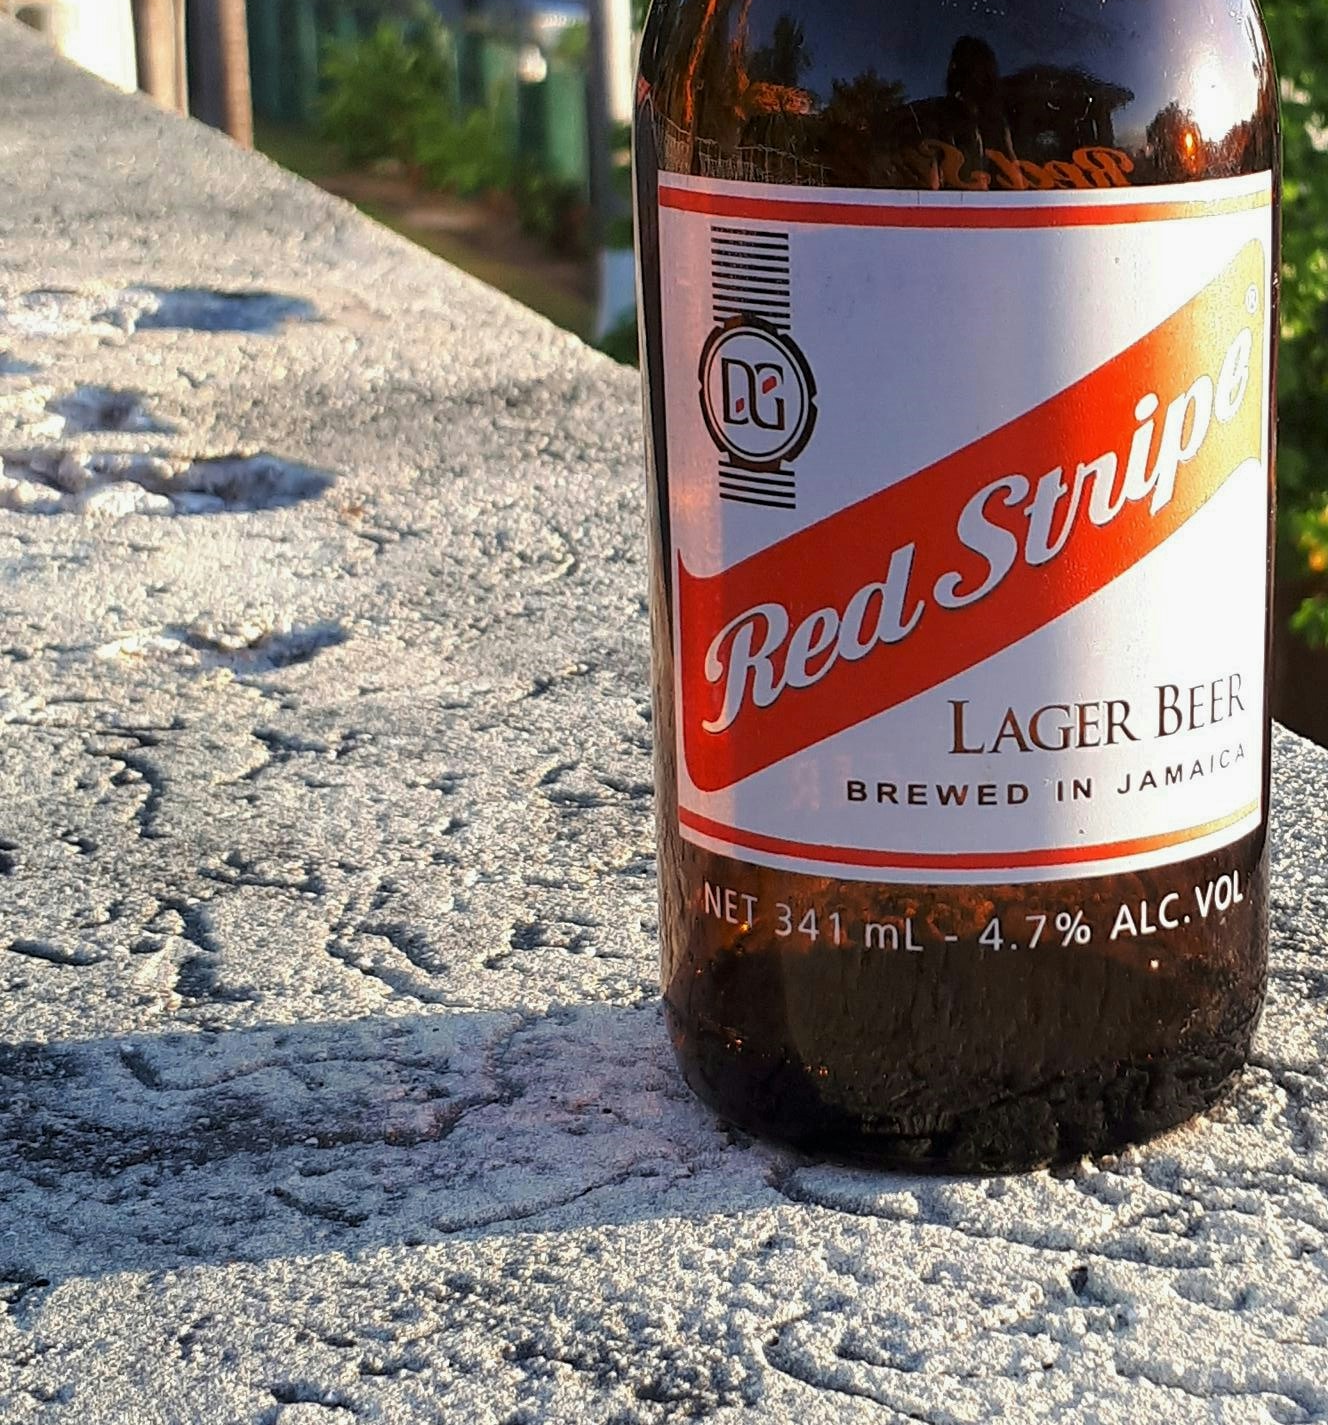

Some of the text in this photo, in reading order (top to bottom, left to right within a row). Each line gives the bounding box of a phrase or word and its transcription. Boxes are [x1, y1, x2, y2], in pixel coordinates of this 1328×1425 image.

[701, 327, 1254, 734] Red Stripe
[947, 672, 1245, 756] LAGER BEER
[846, 742, 1247, 806] BREWED IN JAMAICA
[703, 880, 757, 930] NET
[774, 902, 843, 946] 341
[864, 917, 925, 953] mL
[978, 910, 1092, 953] 4.7%
